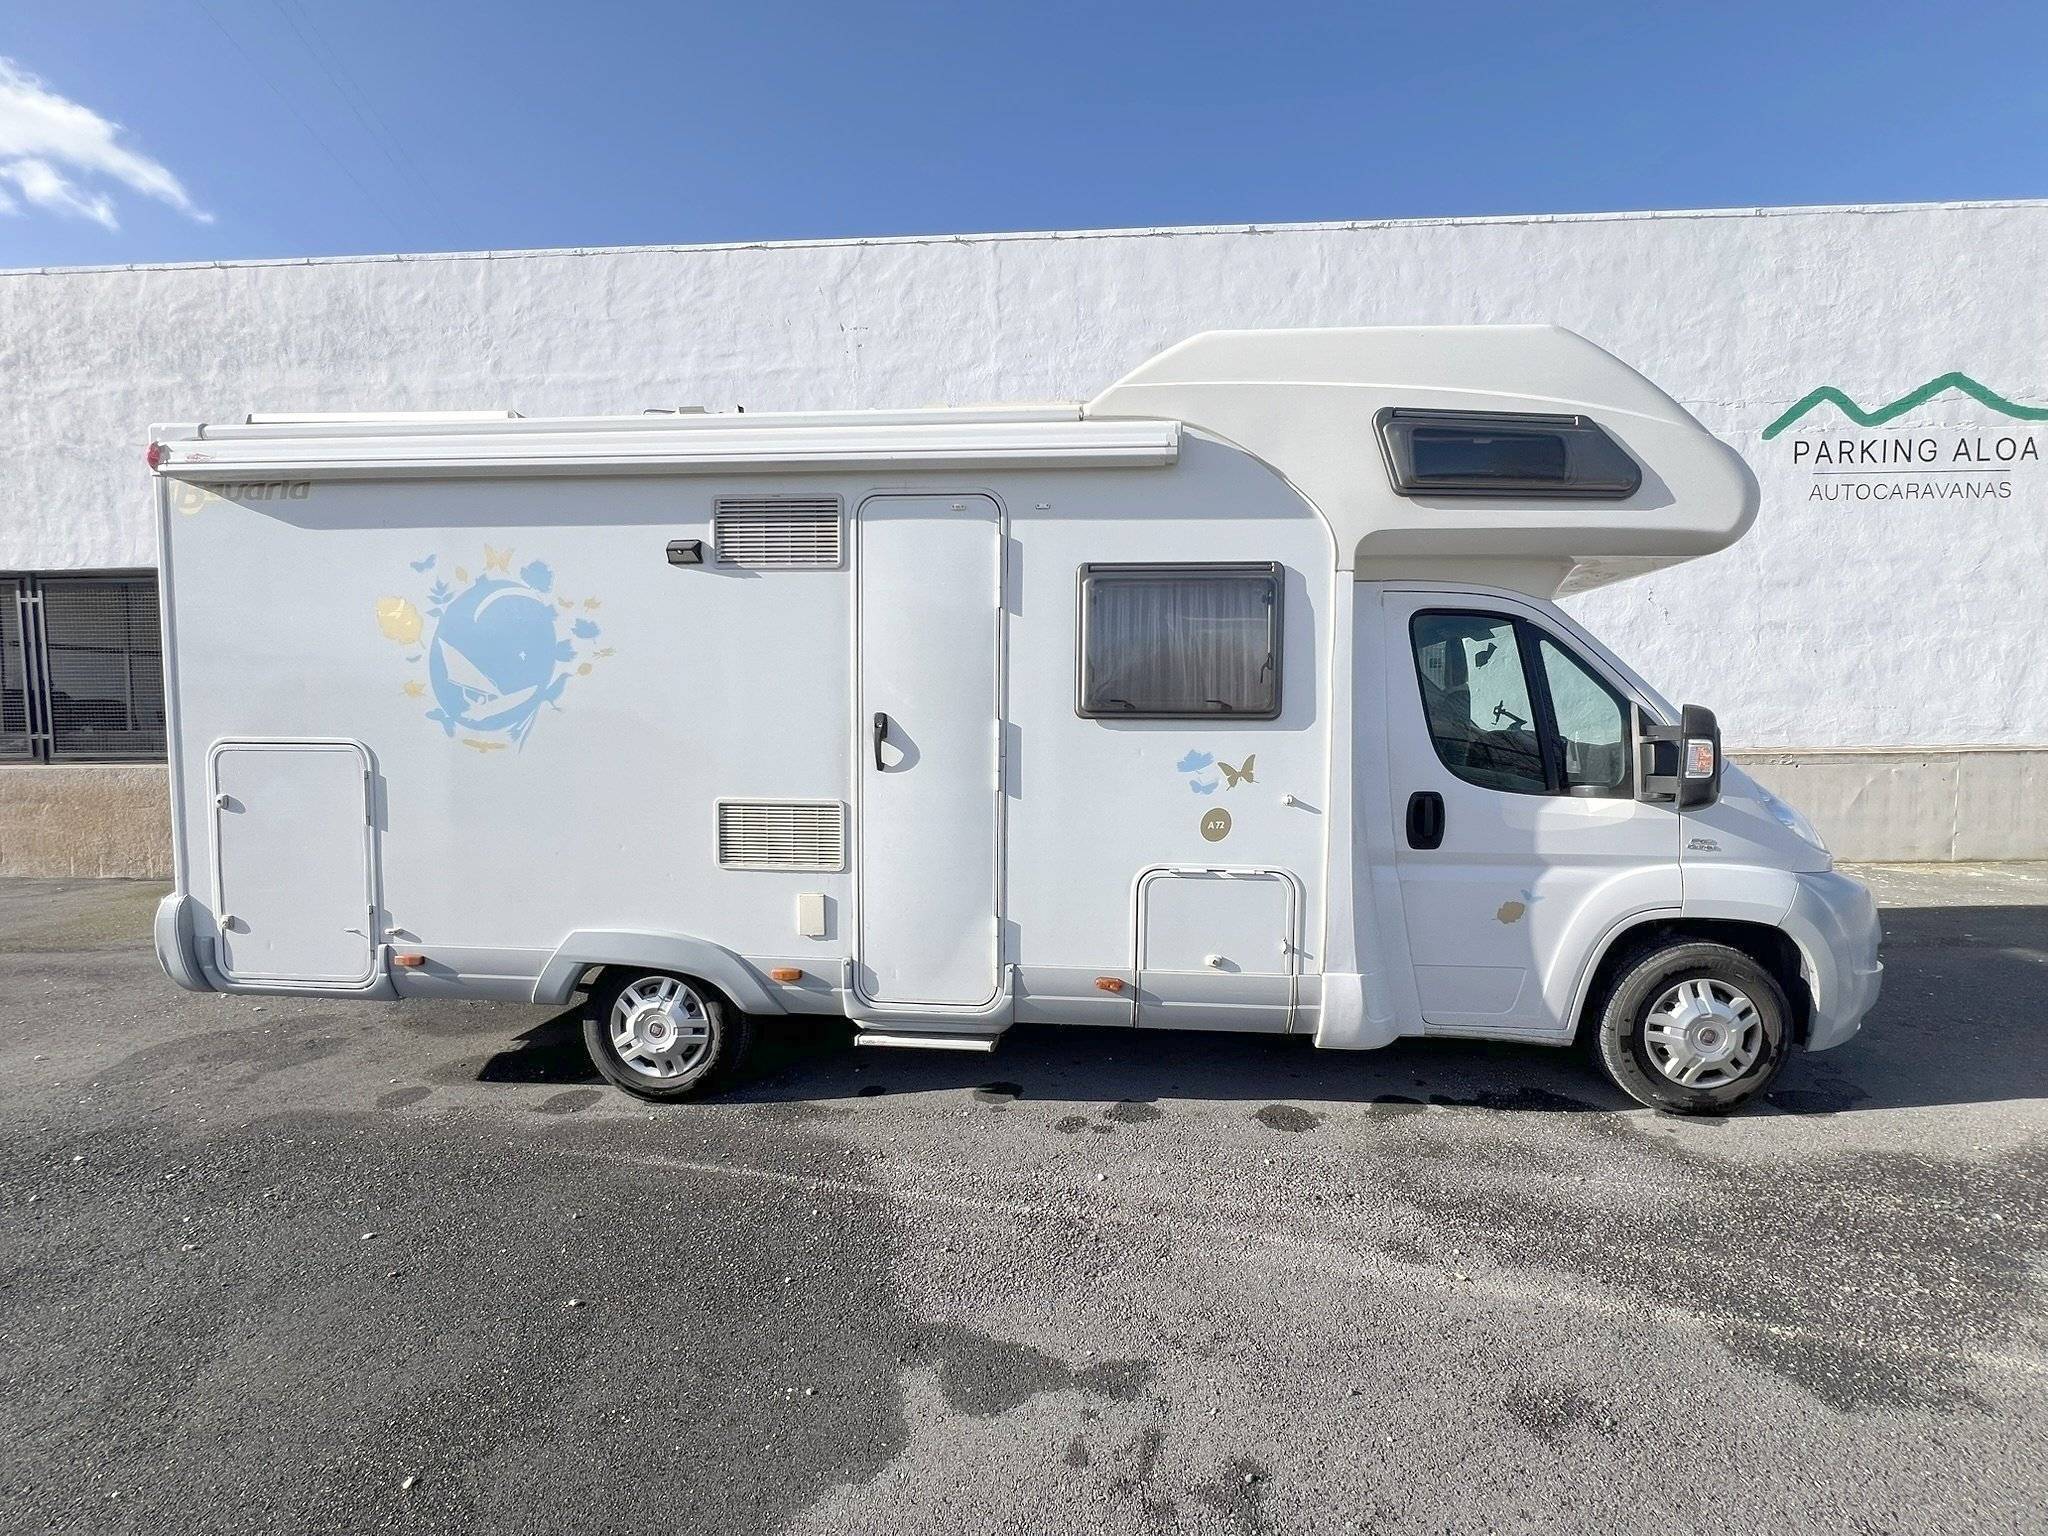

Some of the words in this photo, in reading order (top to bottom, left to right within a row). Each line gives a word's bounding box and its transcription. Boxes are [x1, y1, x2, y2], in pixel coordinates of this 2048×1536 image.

[1793, 438, 1938, 464] PARKING
[1952, 436, 2039, 462] ALOA
[1808, 481, 2012, 501] AUTOCARAVANAS
